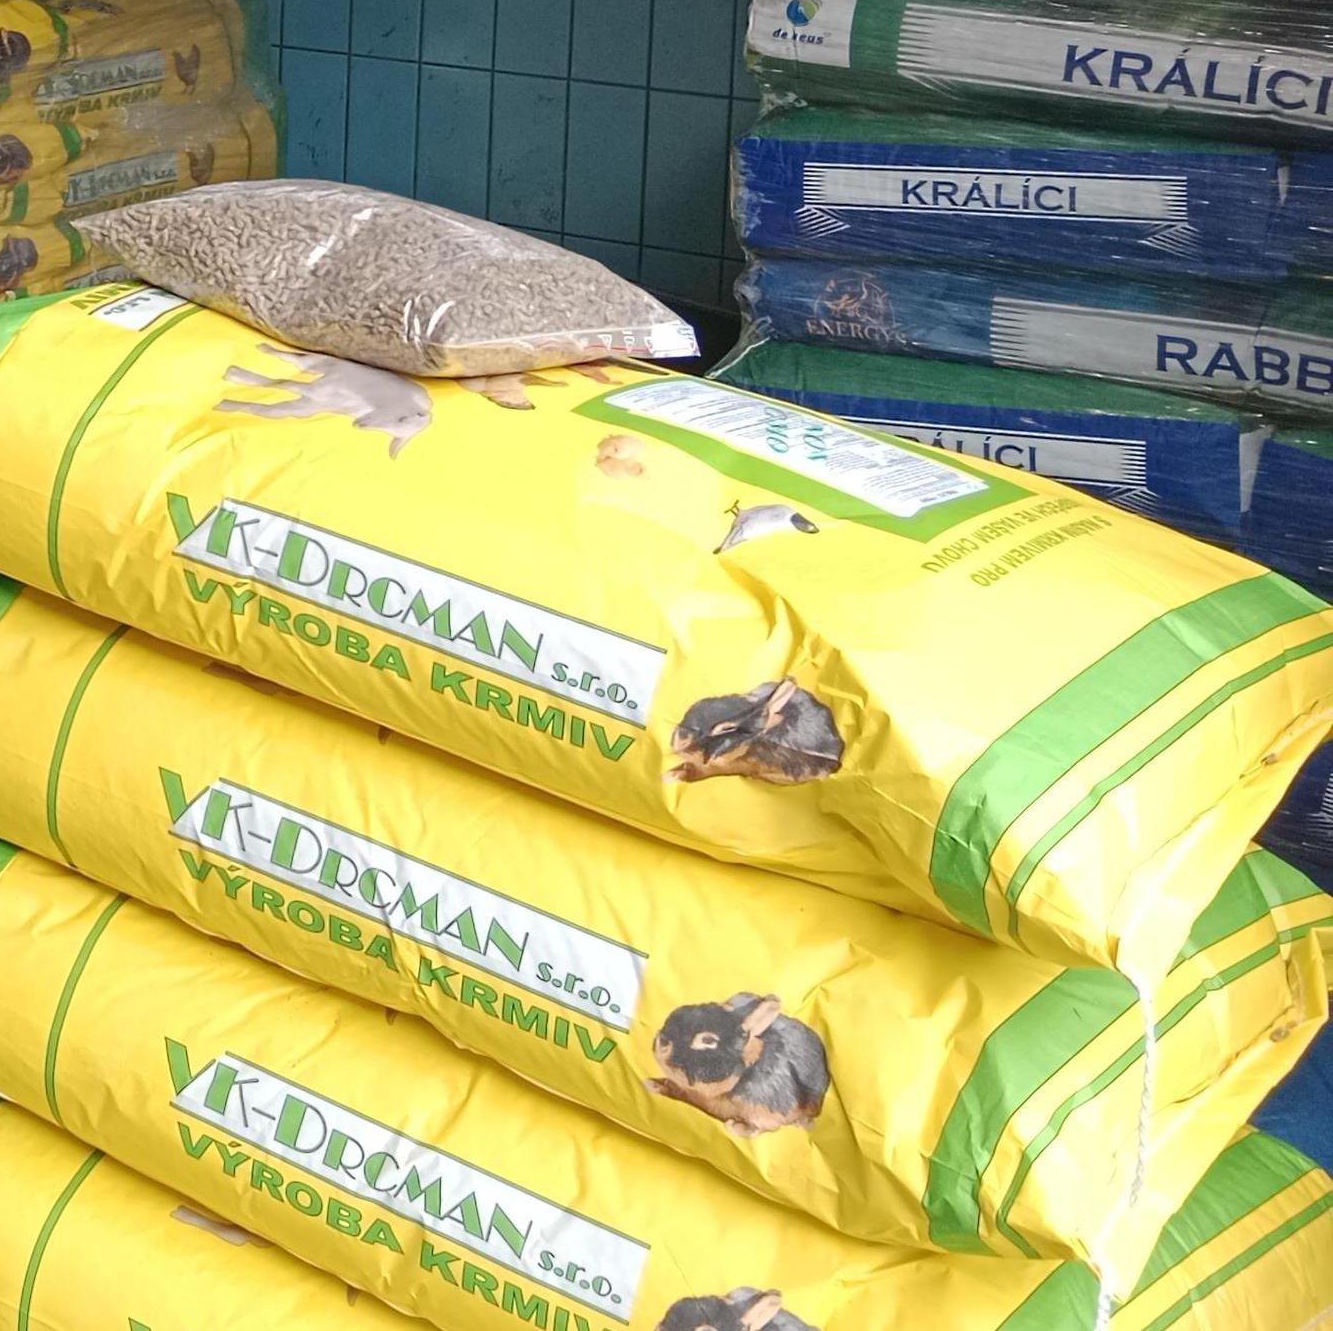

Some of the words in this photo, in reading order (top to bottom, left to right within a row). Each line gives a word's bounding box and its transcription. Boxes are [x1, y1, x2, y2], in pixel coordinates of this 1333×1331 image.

[1063, 44, 1333, 116] KRÁLÍCI
[900, 176, 1079, 214] KRÁLÍCI
[167, 491, 545, 672] VK-DRCMAN
[550, 657, 639, 712] s.r.o.
[181, 568, 412, 682] VÝROBA
[430, 662, 636, 764] KRMIV
[970, 562, 1010, 587] PRO
[158, 765, 531, 974] VK-DRCMAN
[536, 960, 623, 1015] s.r.o.
[178, 848, 400, 973] VÝROBA
[417, 958, 618, 1065] KRMIV
[164, 1036, 533, 1260] VK-DRCMAN
[537, 1251, 623, 1306] s.r.o.
[176, 1121, 404, 1255] VÝROBA
